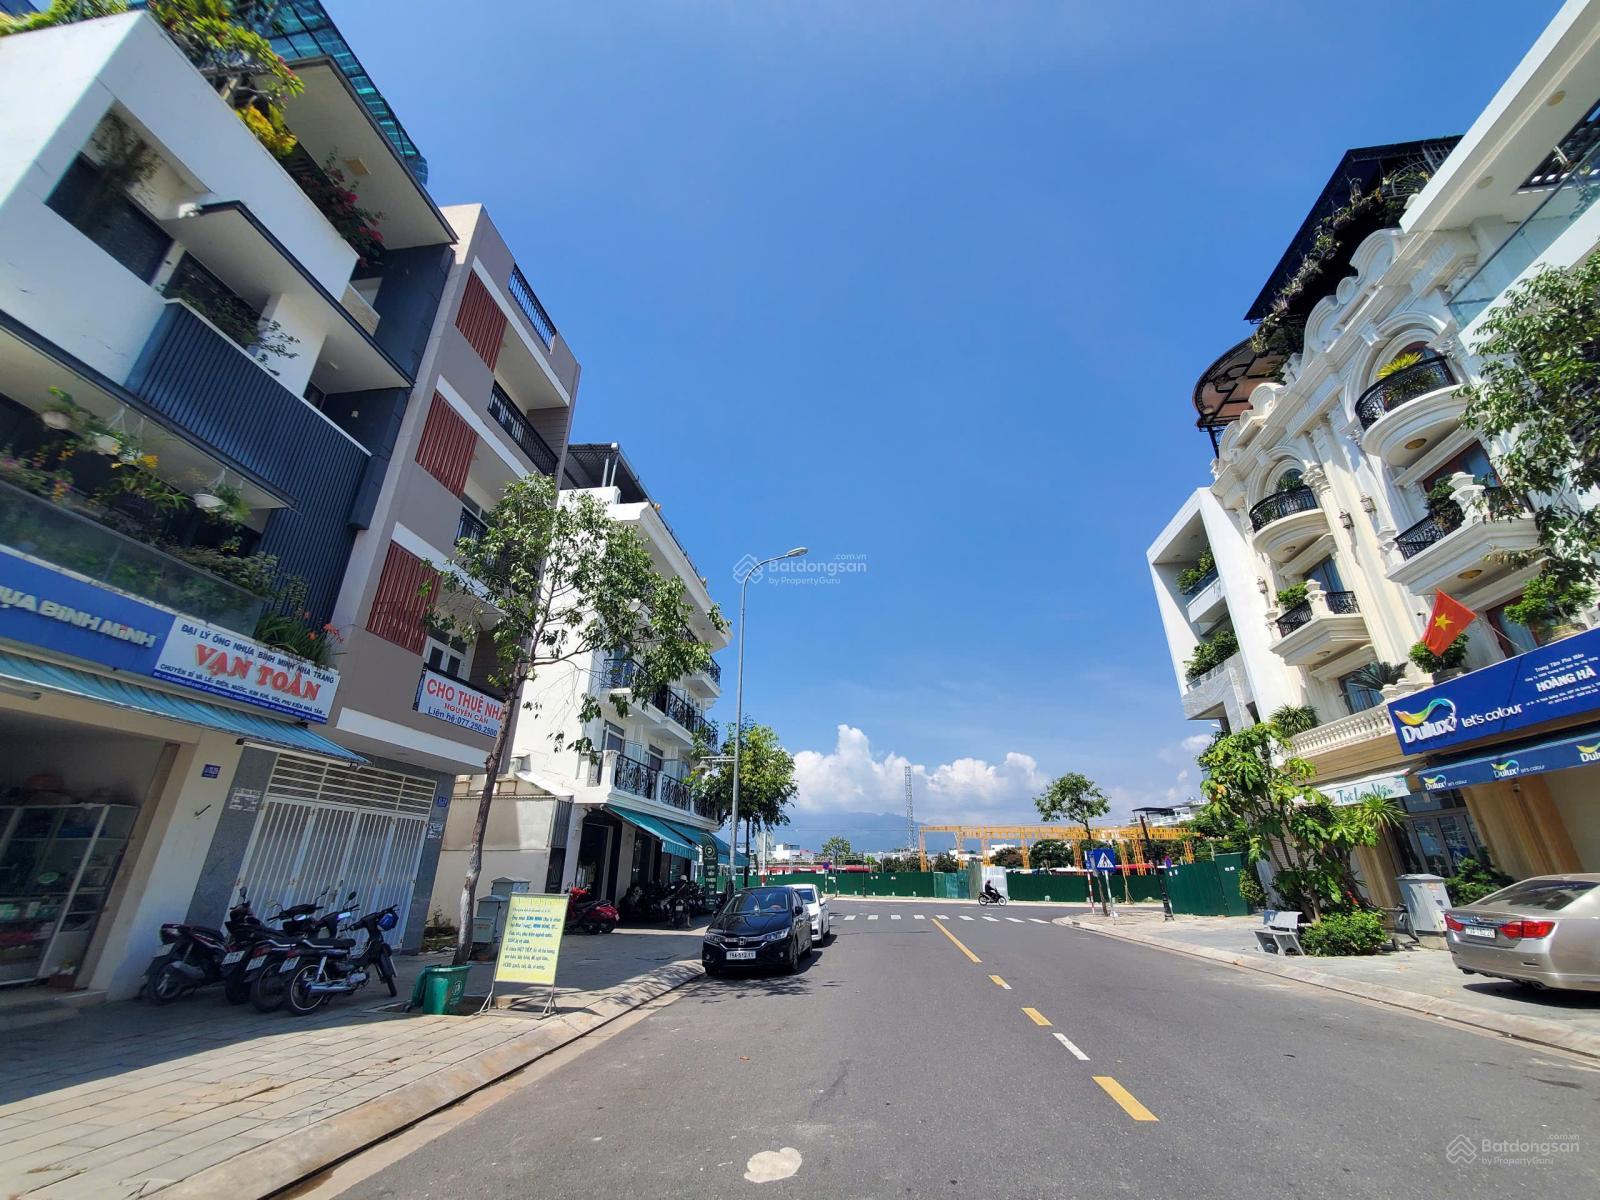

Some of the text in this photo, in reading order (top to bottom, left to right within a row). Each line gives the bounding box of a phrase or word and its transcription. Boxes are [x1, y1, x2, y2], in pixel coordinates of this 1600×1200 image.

[296, 664, 311, 676] NHA
[1536, 673, 1577, 693] HOÀNG
[1576, 665, 1597, 680] HÀ
[426, 678, 455, 702] CHO
[458, 690, 485, 714] THUÊ
[427, 706, 445, 718] Liên
[1400, 703, 1523, 744] Dulux let's colour
[1493, 767, 1518, 778] Dulux
[1425, 780, 1446, 791] Dulux
